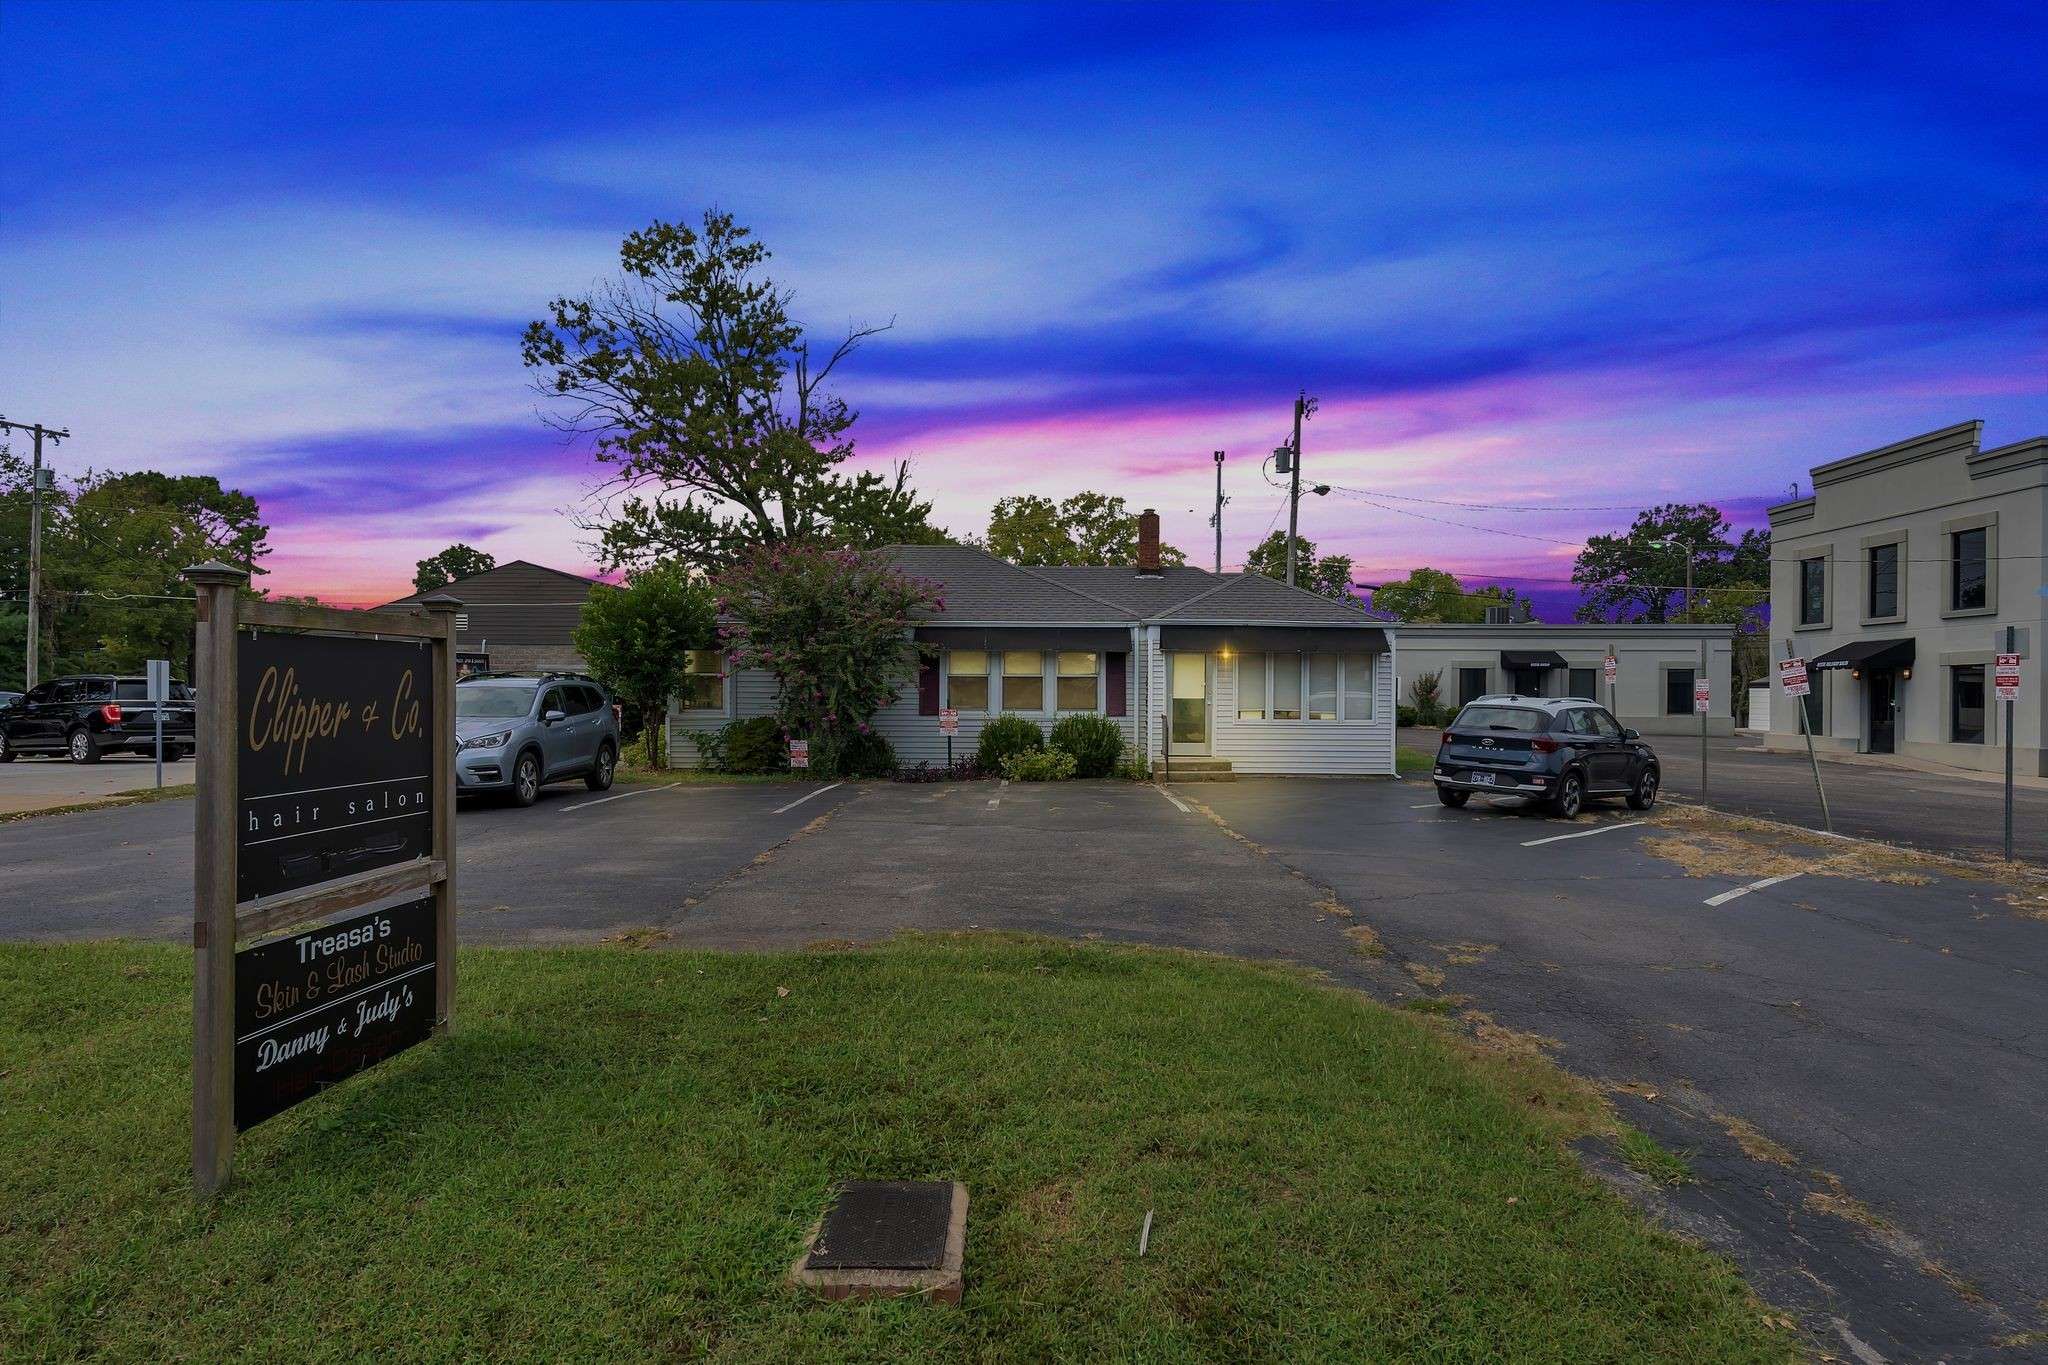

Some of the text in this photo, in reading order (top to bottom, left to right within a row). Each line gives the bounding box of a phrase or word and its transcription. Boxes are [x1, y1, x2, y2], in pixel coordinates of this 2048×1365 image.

[249, 666, 351, 776] Clipper
[392, 669, 423, 741] Co.
[249, 791, 424, 831] hair salon
[255, 936, 424, 1019] Skin & Lash Studio
[296, 916, 392, 964] Treasa's
[256, 1025, 330, 1073] Danny
[337, 1017, 347, 1035] &
[354, 984, 414, 1038] Judy's
